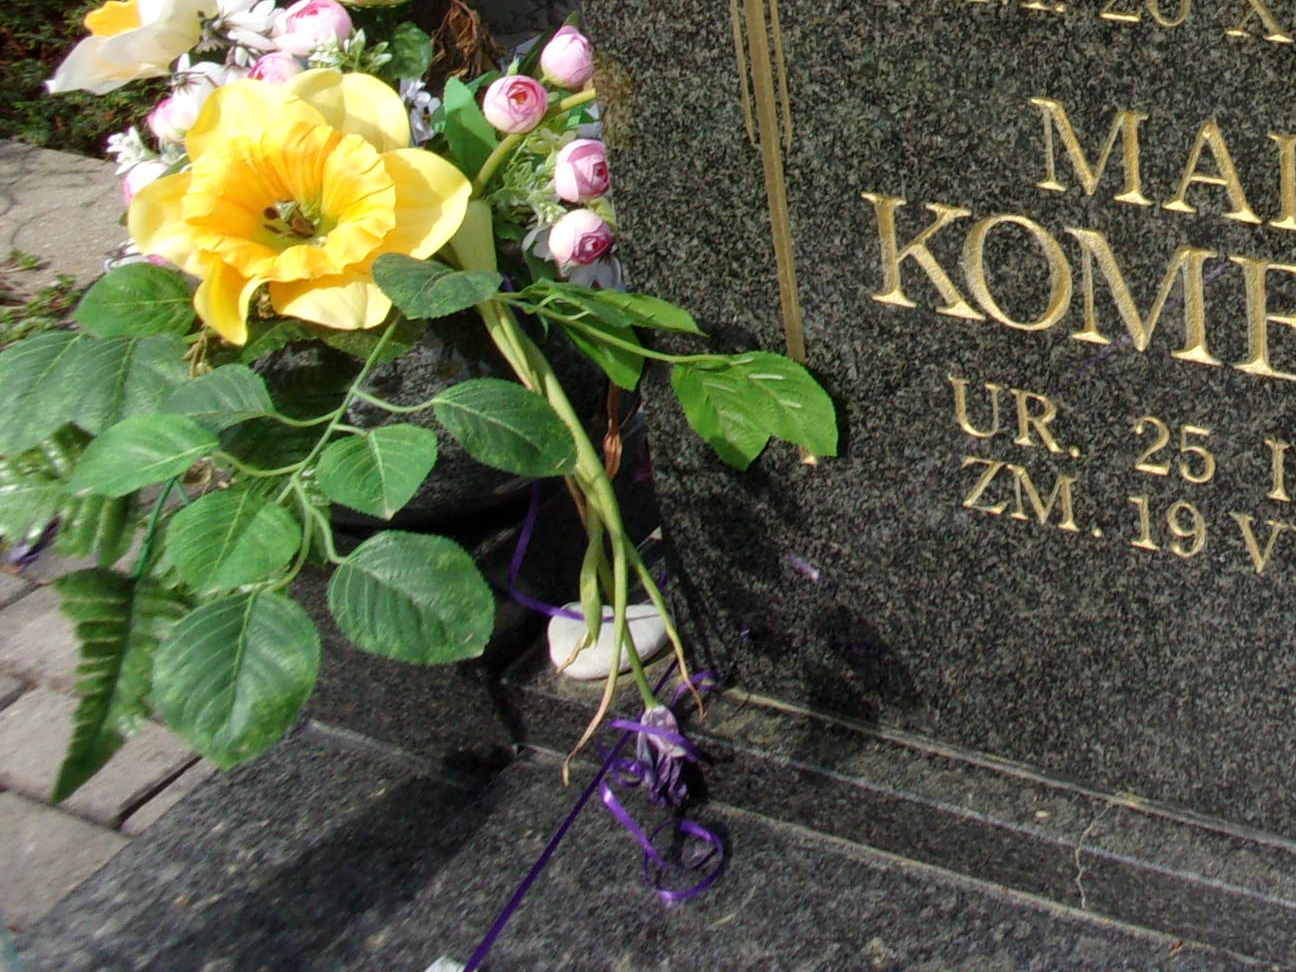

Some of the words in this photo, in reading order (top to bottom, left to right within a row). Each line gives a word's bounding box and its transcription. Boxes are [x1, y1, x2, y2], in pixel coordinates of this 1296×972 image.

[948, 375, 1082, 459] UR.
[1134, 415, 1216, 485] 25
[960, 456, 1104, 538] ZM.
[1128, 494, 1208, 559] 19
